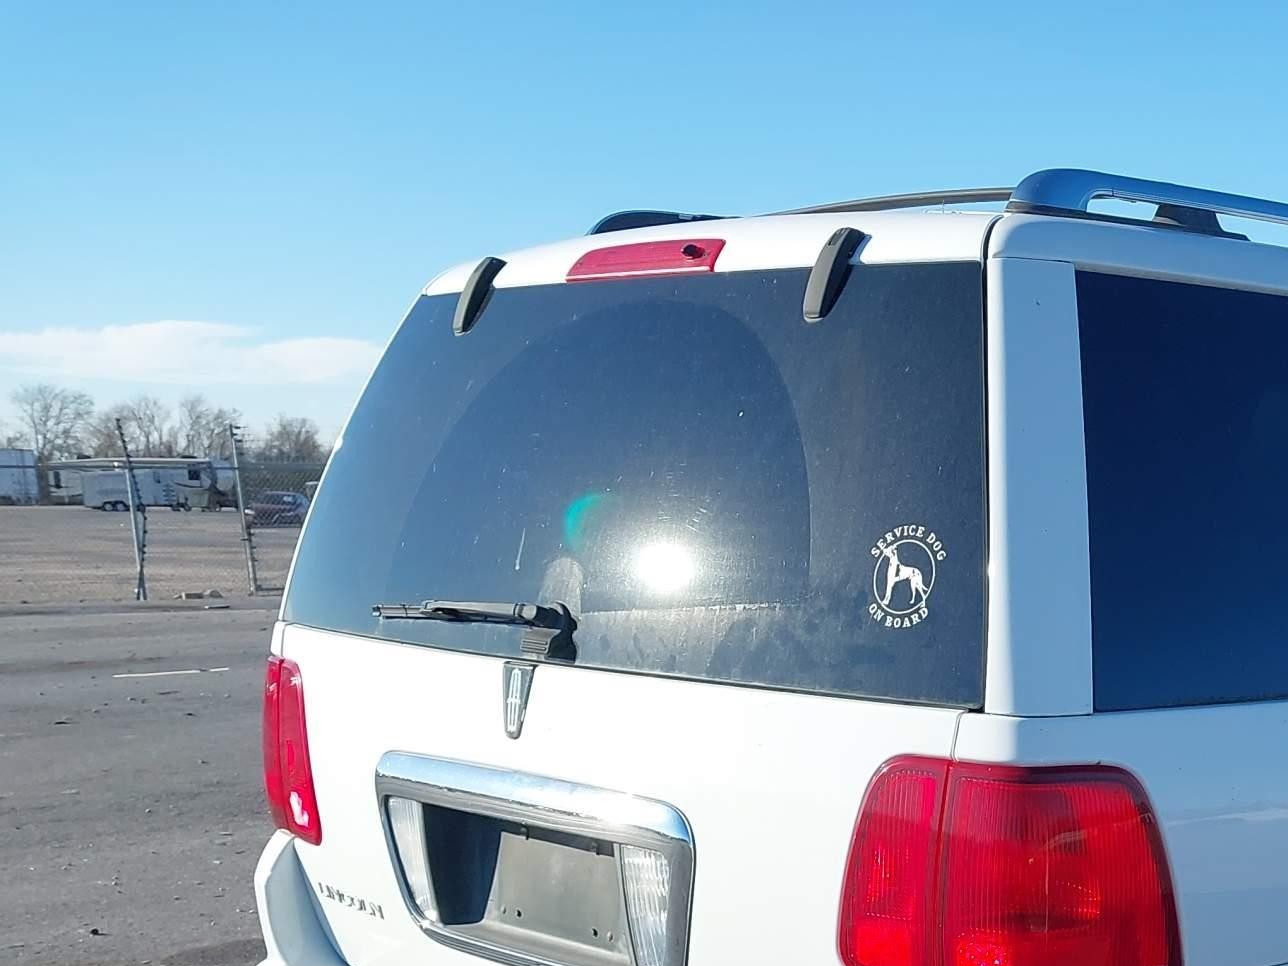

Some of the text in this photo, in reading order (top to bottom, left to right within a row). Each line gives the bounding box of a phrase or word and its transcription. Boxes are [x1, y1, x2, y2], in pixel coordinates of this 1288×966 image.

[871, 525, 947, 561] SERVICE DOG
[868, 603, 928, 628] ON BOARD
